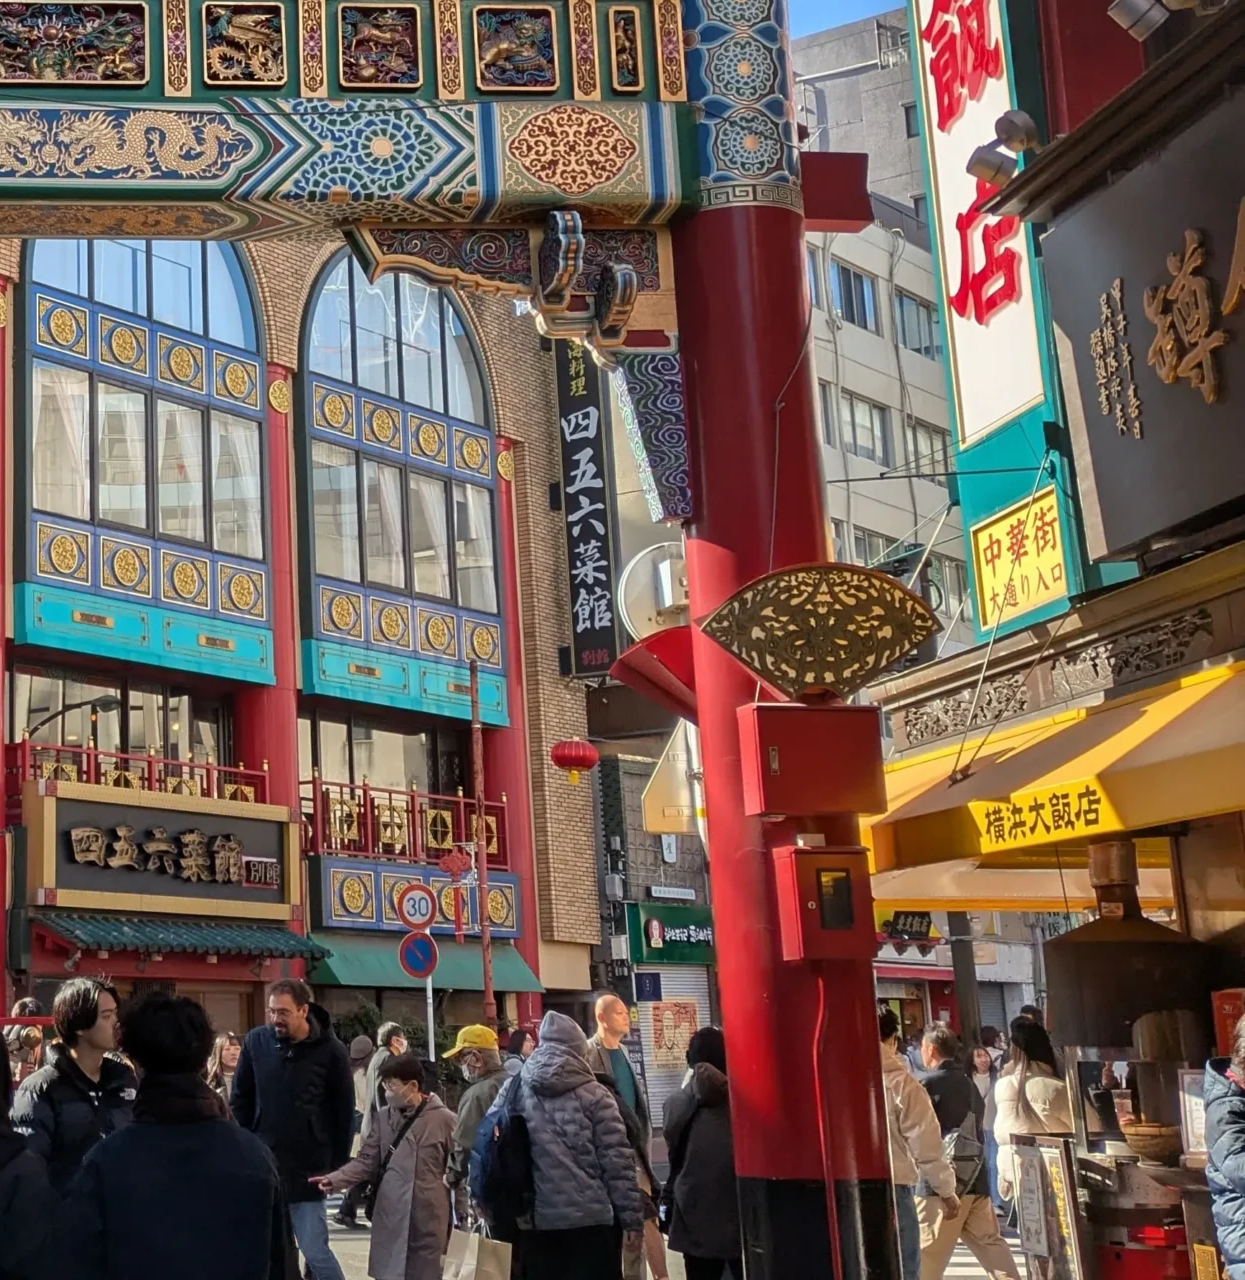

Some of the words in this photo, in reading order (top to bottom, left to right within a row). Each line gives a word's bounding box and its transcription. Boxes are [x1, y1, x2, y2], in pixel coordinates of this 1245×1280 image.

[561, 406, 613, 634] 四五六菜館
[983, 504, 1058, 578] 中華街
[989, 562, 1063, 620] 大通り入口
[984, 785, 1102, 845] 横浜大飯店
[70, 824, 245, 884] 四五六菜館
[249, 860, 281, 885] 別館
[406, 896, 430, 917] 30
